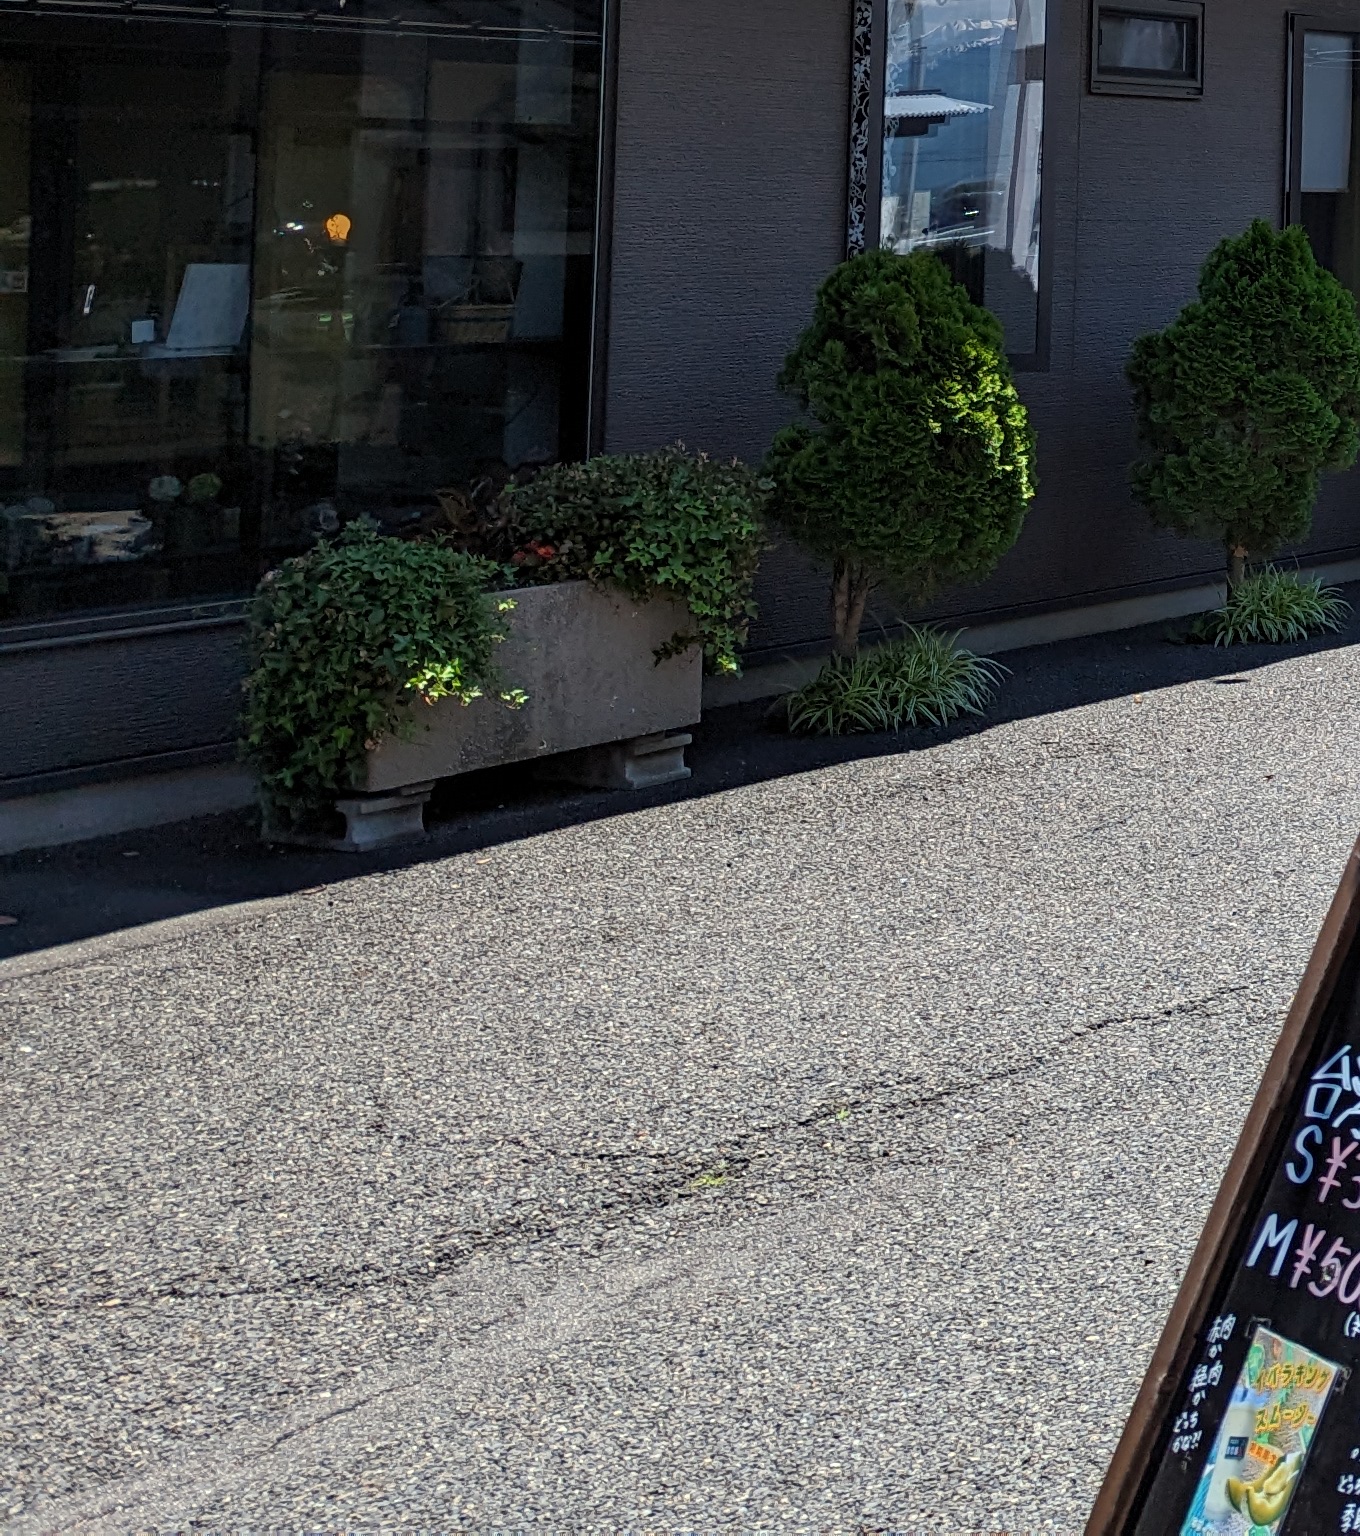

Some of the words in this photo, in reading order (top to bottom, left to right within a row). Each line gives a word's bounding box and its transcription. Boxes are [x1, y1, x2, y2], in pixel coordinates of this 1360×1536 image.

[1284, 1124, 1323, 1184] S
[1246, 1212, 1299, 1277] M
[1255, 1402, 1317, 1434] スムージー
